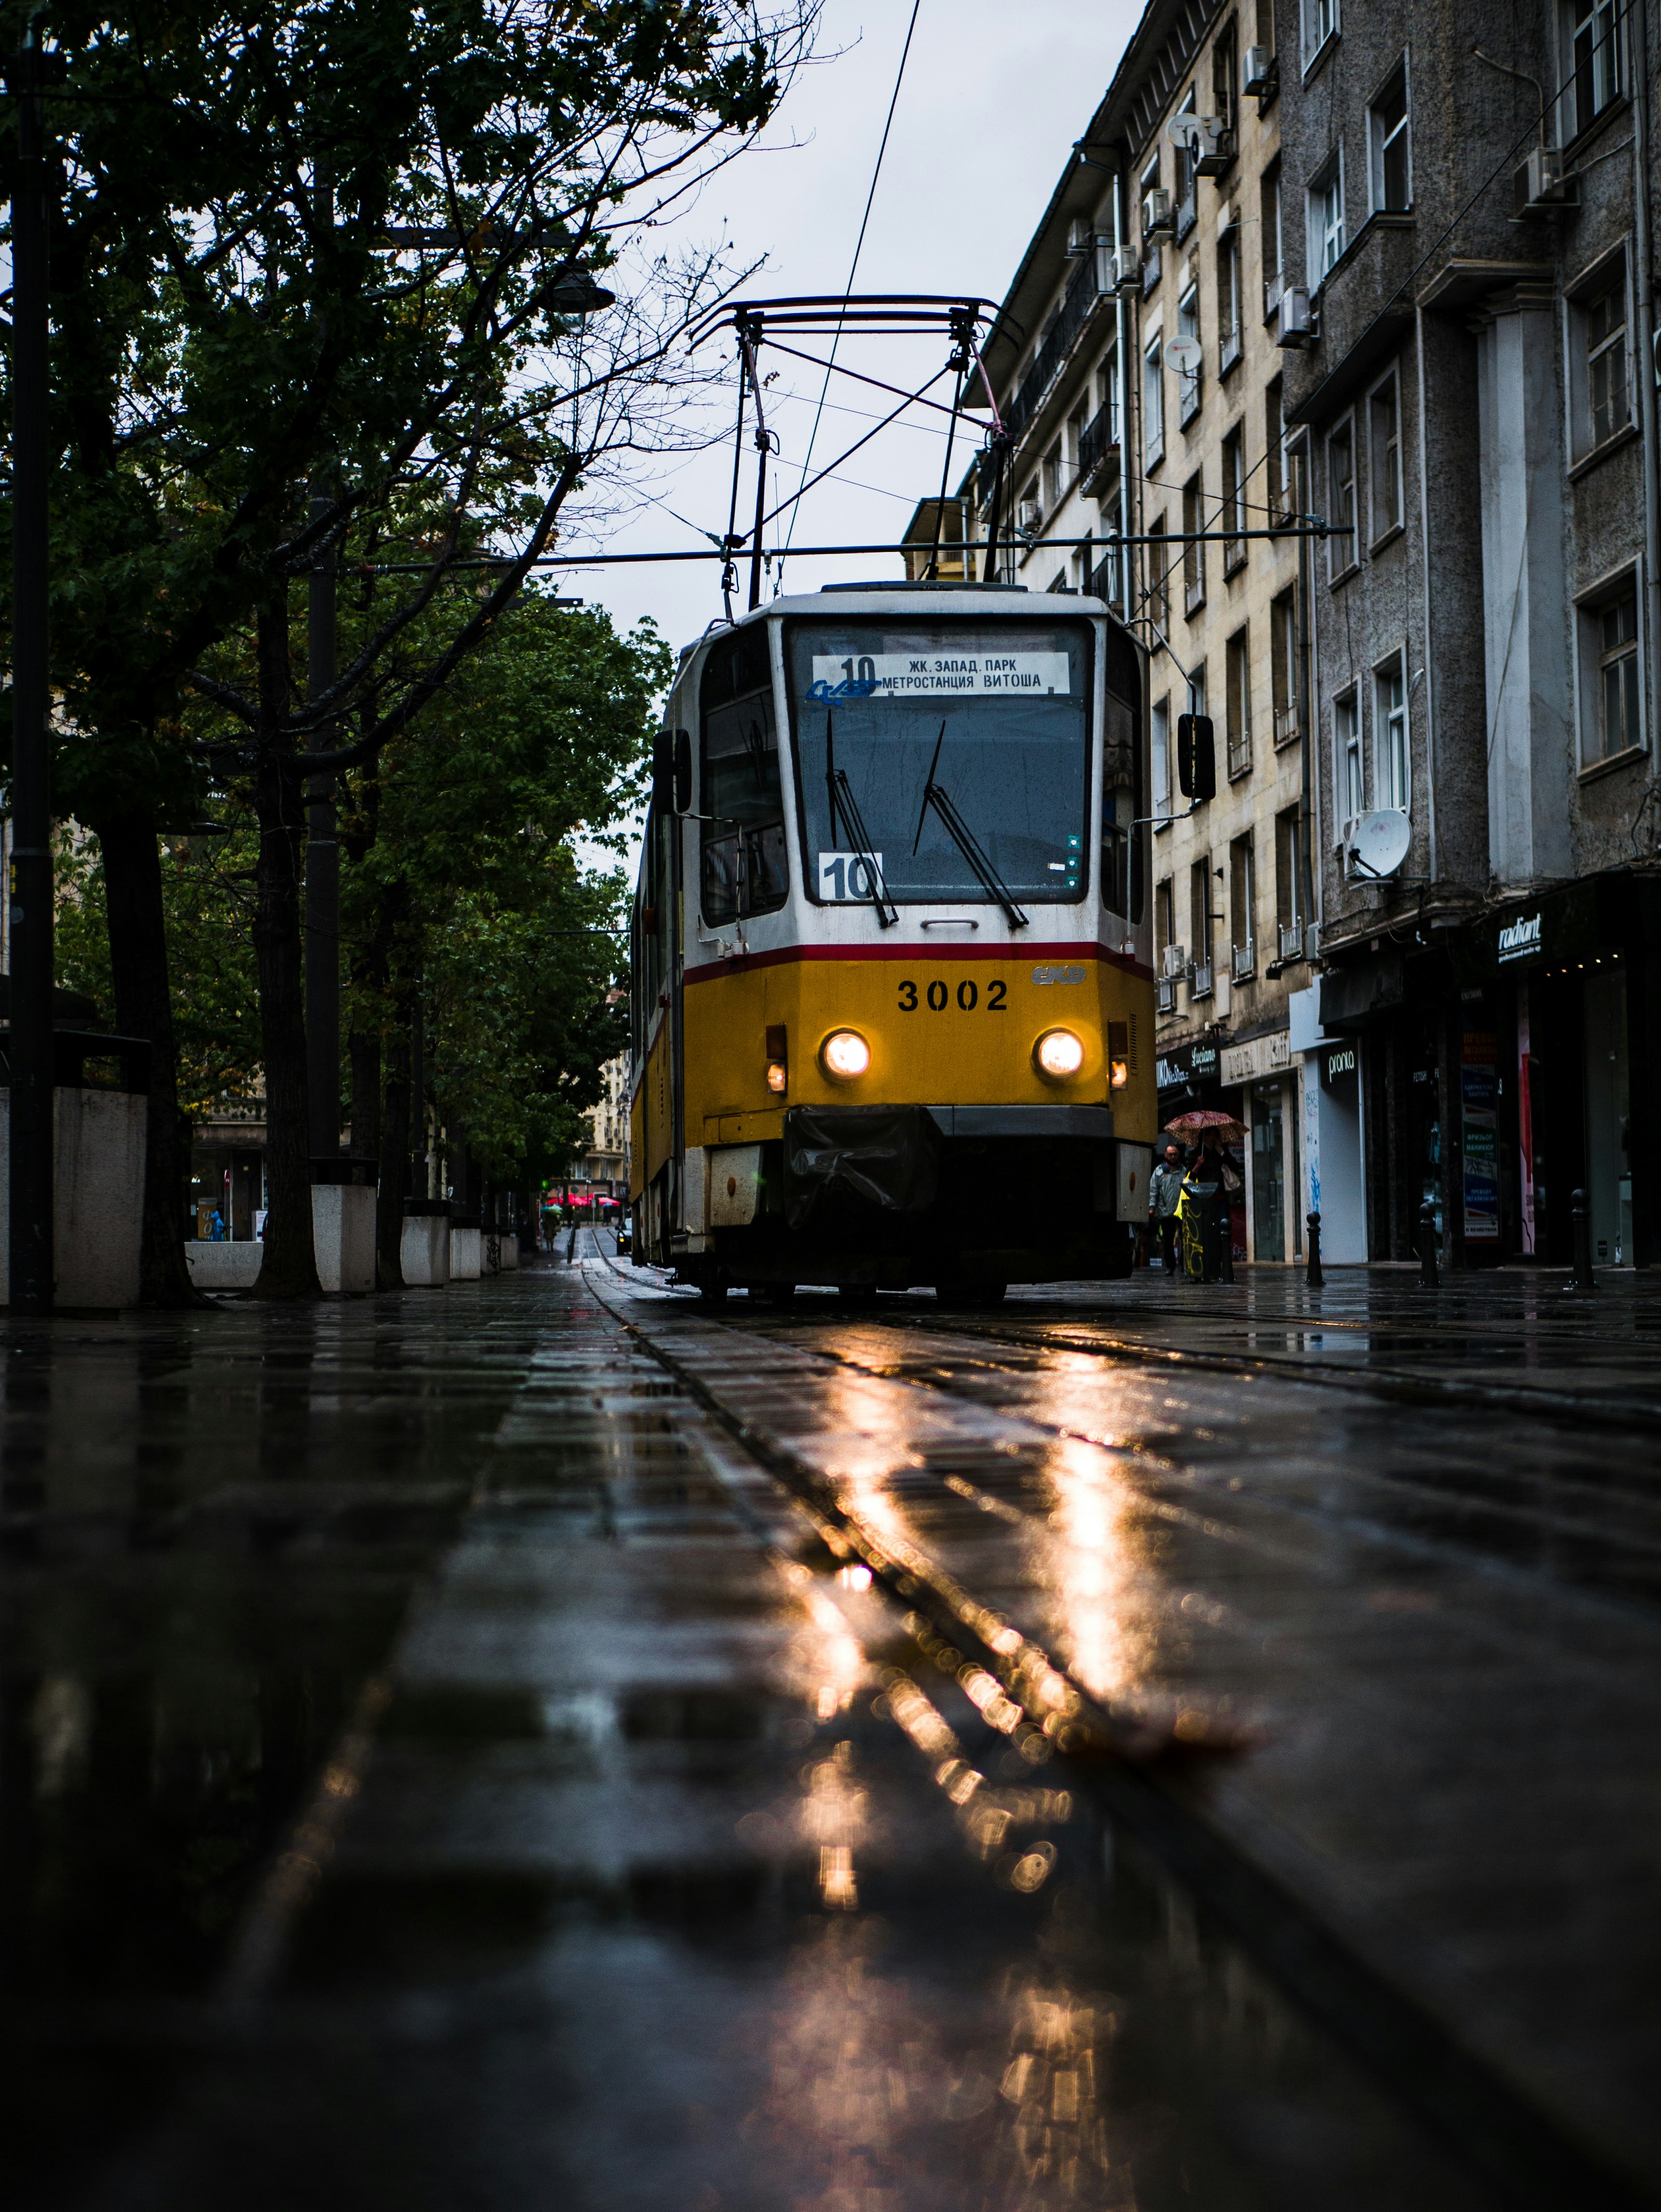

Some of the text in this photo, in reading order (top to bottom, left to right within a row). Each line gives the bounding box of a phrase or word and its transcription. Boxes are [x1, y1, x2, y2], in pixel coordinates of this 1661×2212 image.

[841, 656, 876, 695] 10
[882, 673, 1041, 690] МЕТРОСТАНЦИЯ ВИТОША
[910, 659, 1017, 674] ЖК. ЗАПАД. ПАРК
[824, 857, 877, 899] 10
[1499, 913, 1541, 950] radiant
[898, 980, 1007, 1012] 3002
[1191, 1046, 1215, 1067] Luciano
